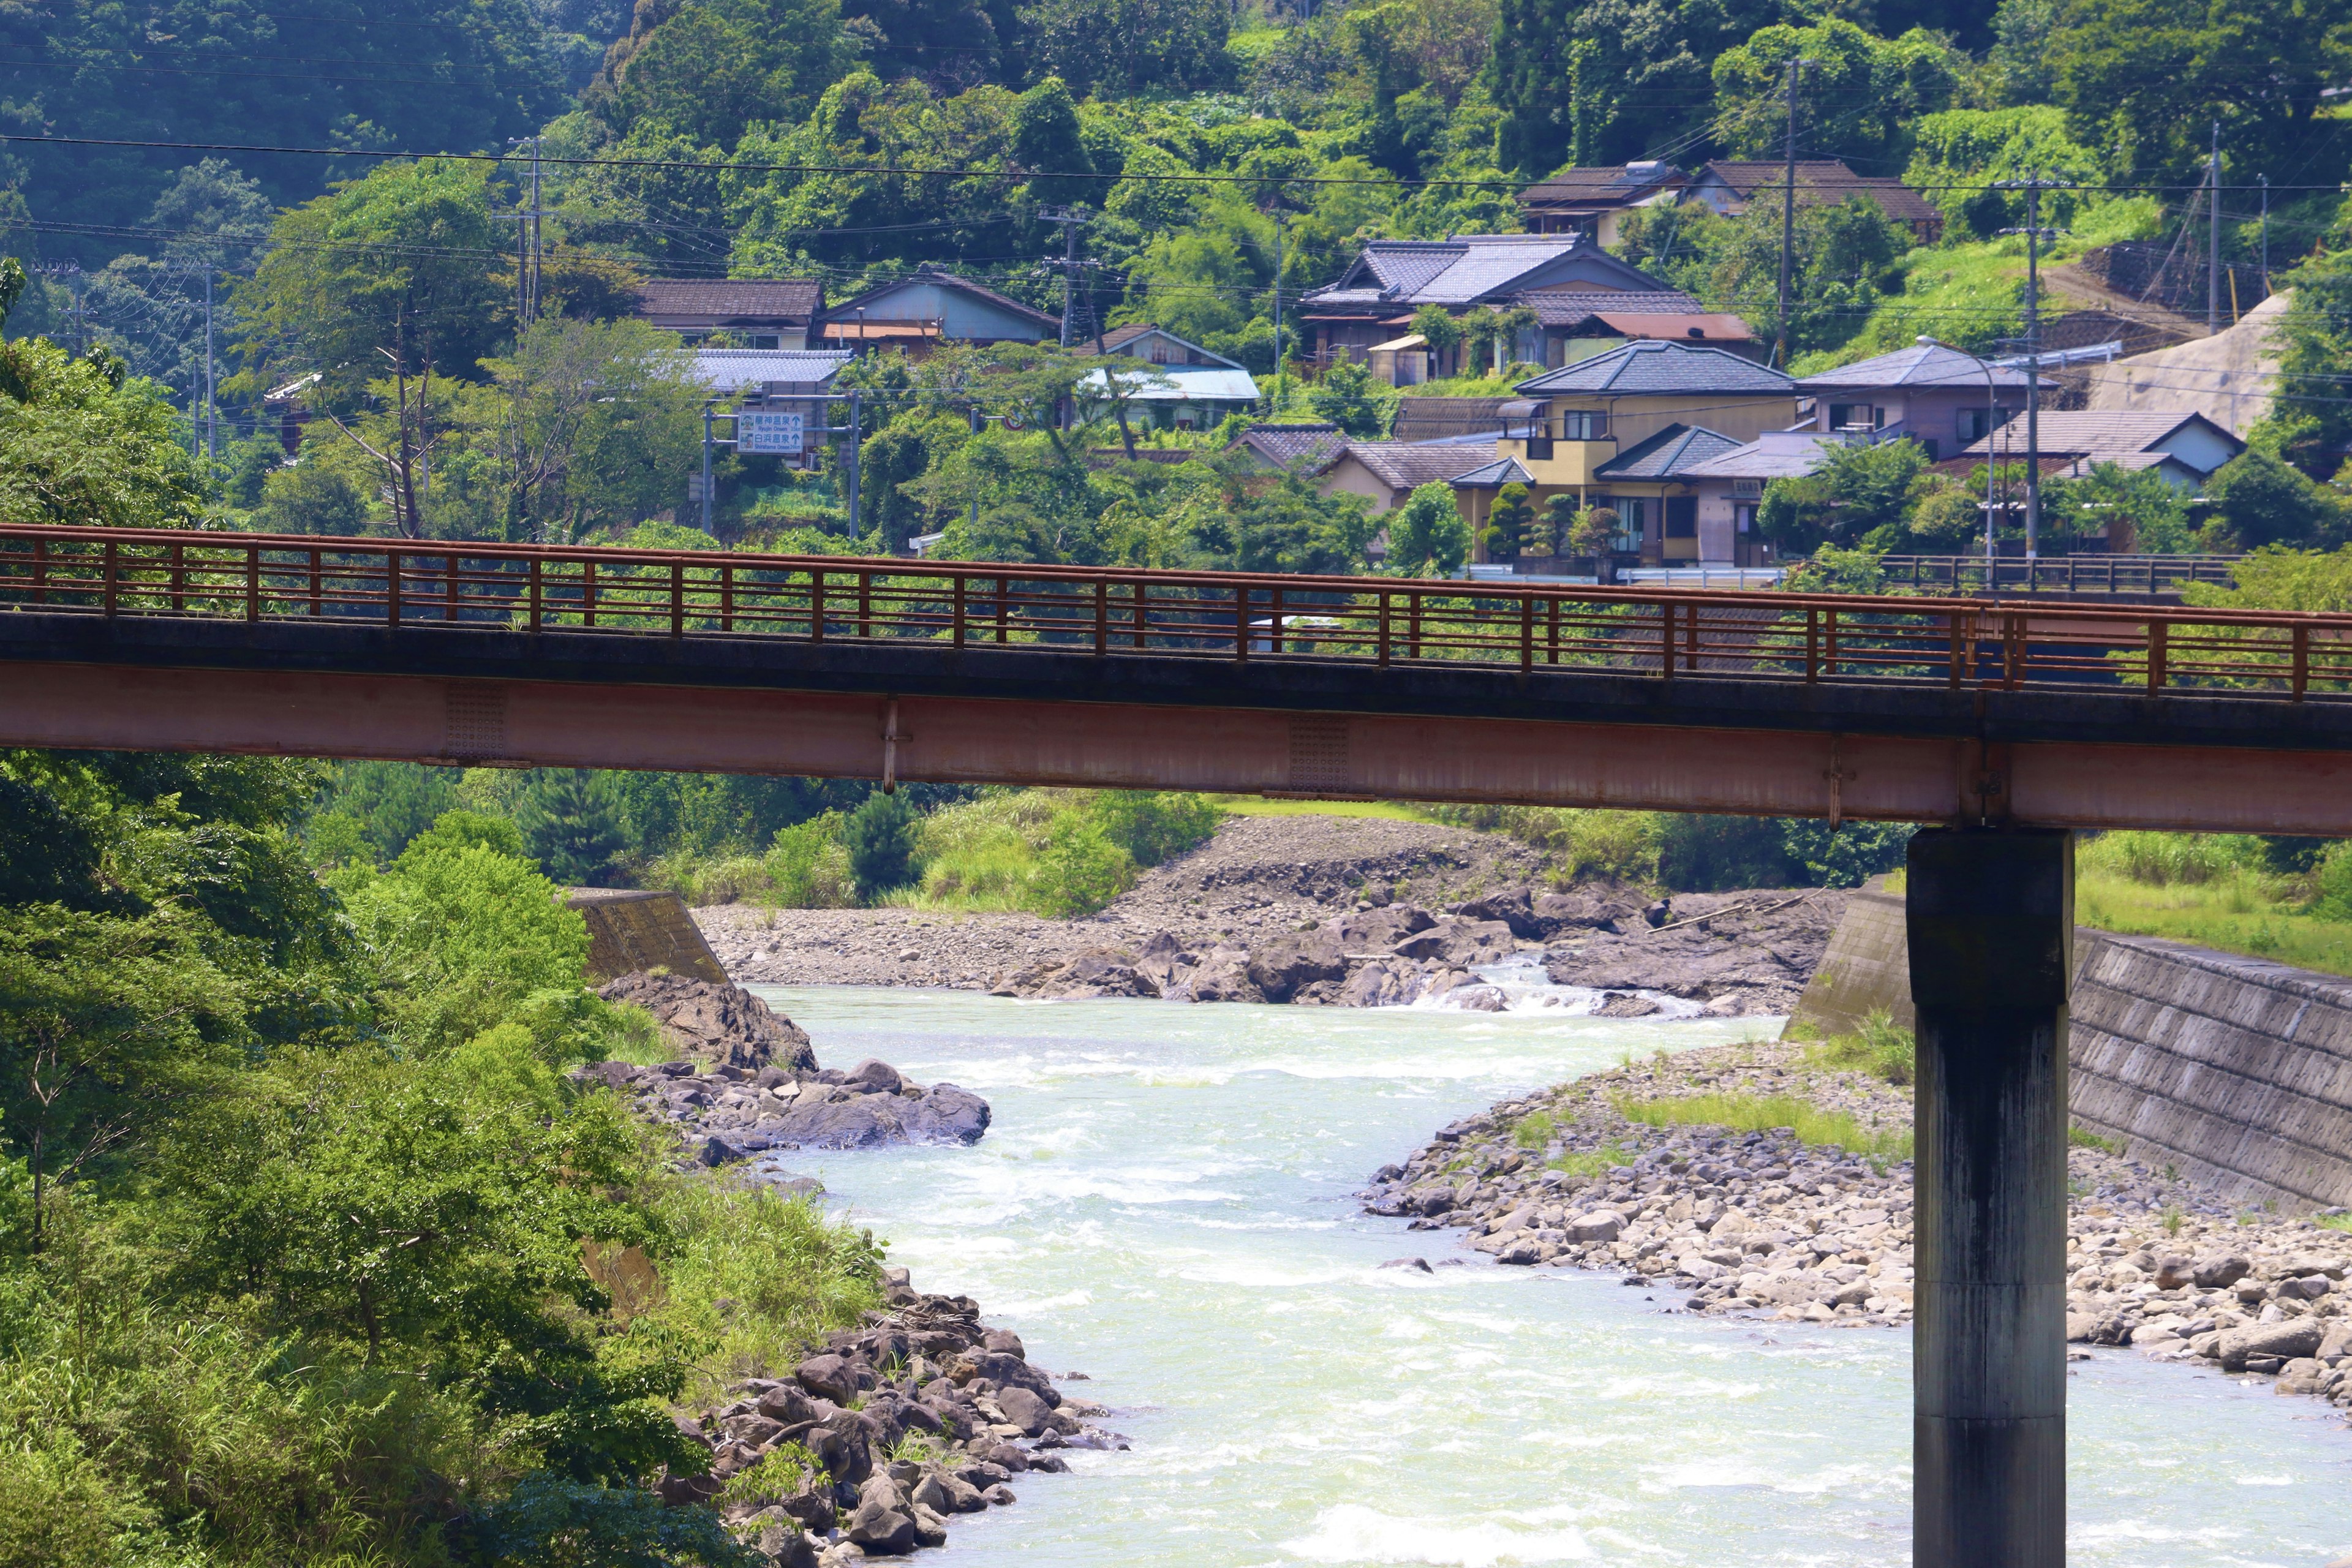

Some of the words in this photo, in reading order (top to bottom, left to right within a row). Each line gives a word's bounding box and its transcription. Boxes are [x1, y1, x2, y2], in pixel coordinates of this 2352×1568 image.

[755, 416, 790, 425] 龍神温泉
[755, 434, 790, 443] 白浜温泉
